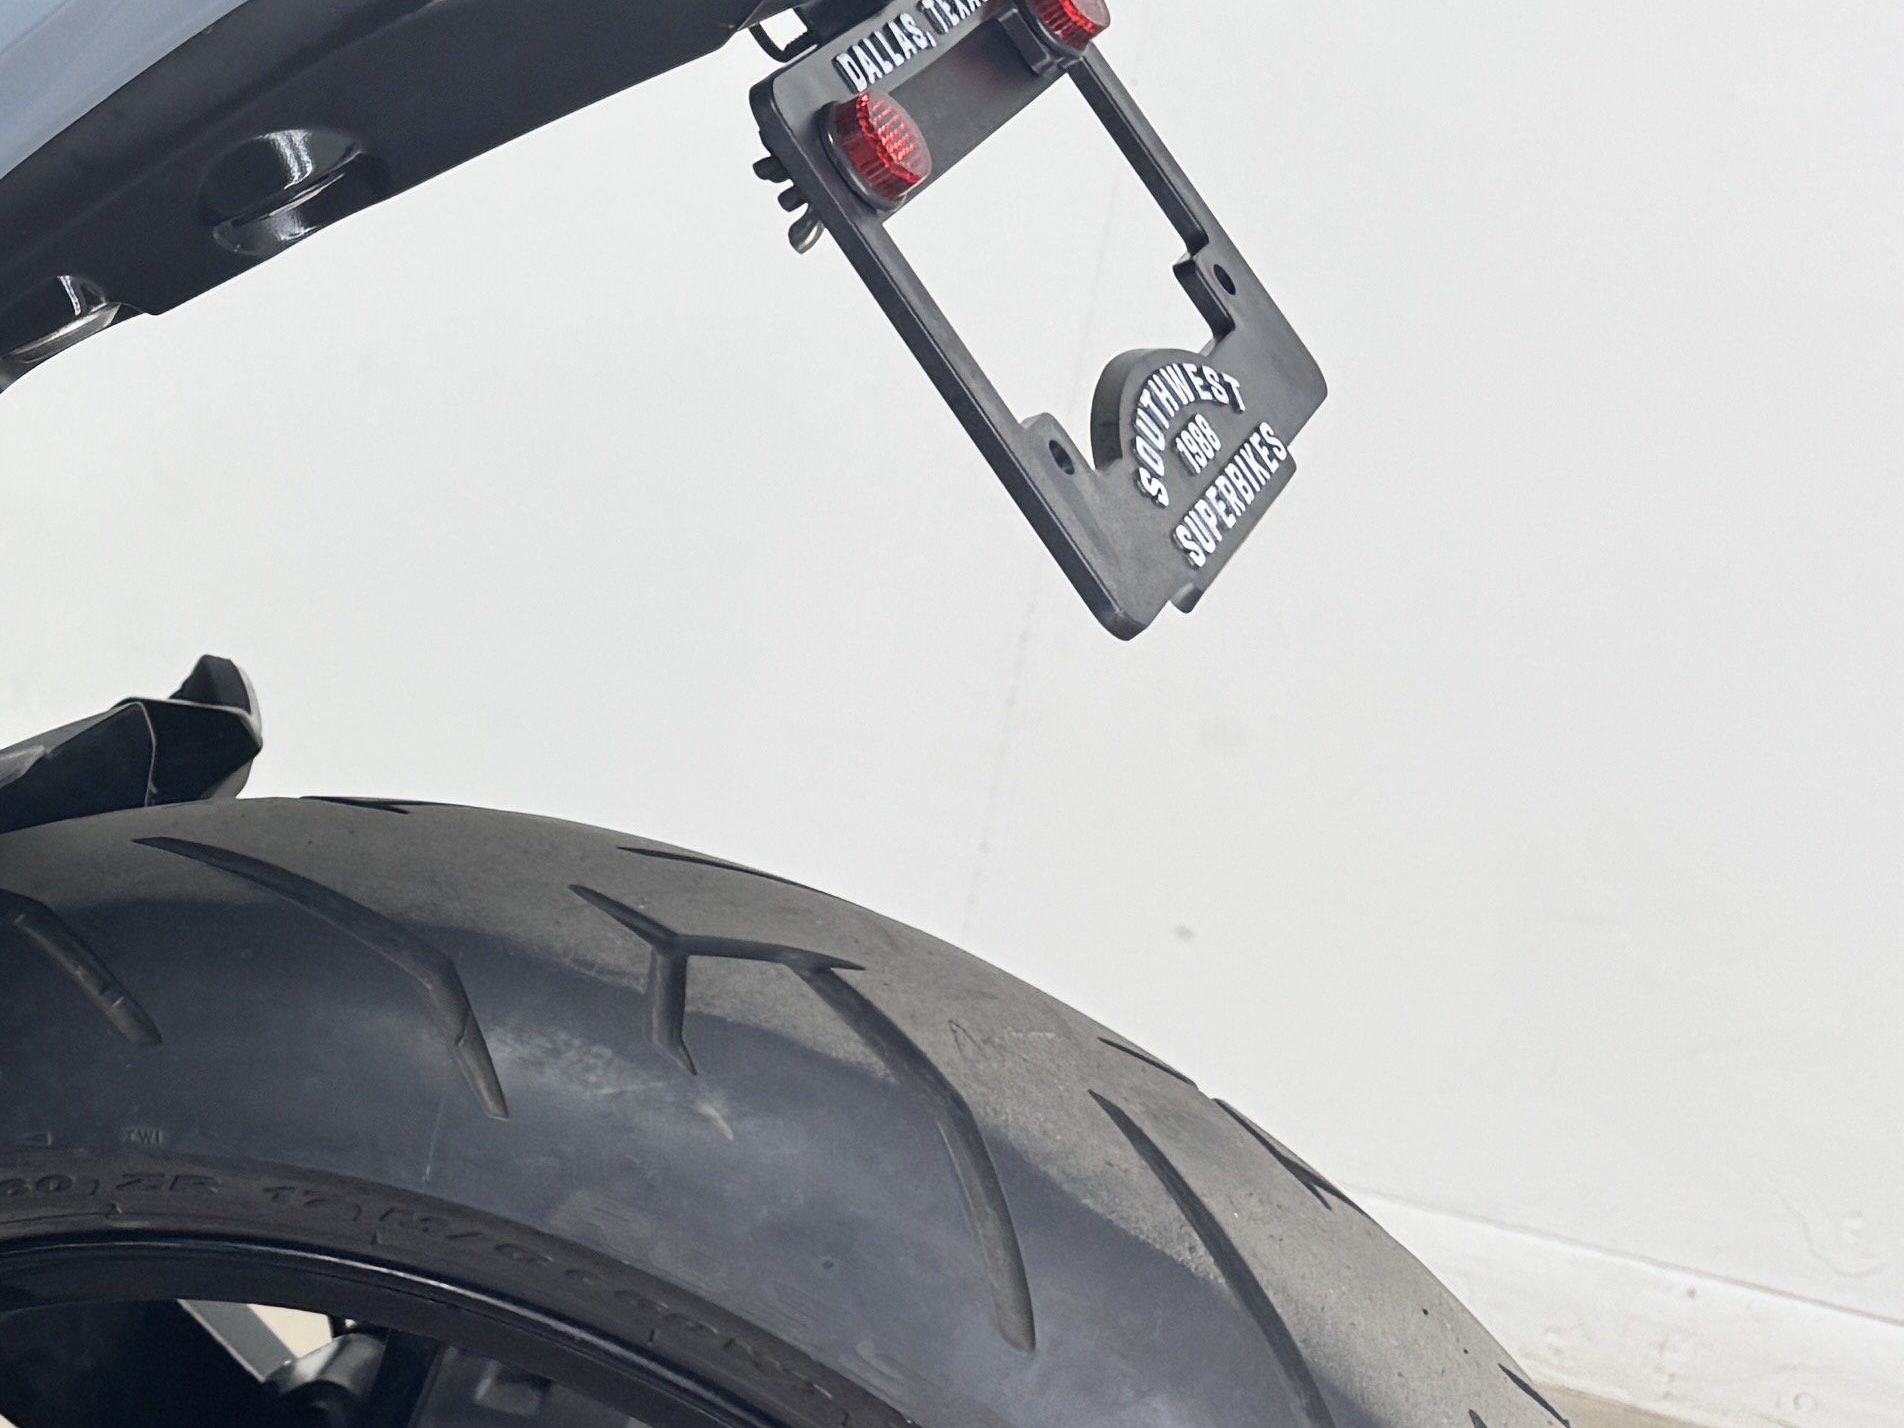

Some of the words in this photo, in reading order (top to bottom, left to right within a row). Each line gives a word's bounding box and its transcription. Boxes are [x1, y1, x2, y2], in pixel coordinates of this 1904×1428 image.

[1133, 362, 1246, 507] SOUTHWEST
[1173, 413, 1222, 476] 1988
[1173, 421, 1289, 569] SUPERBIKES
